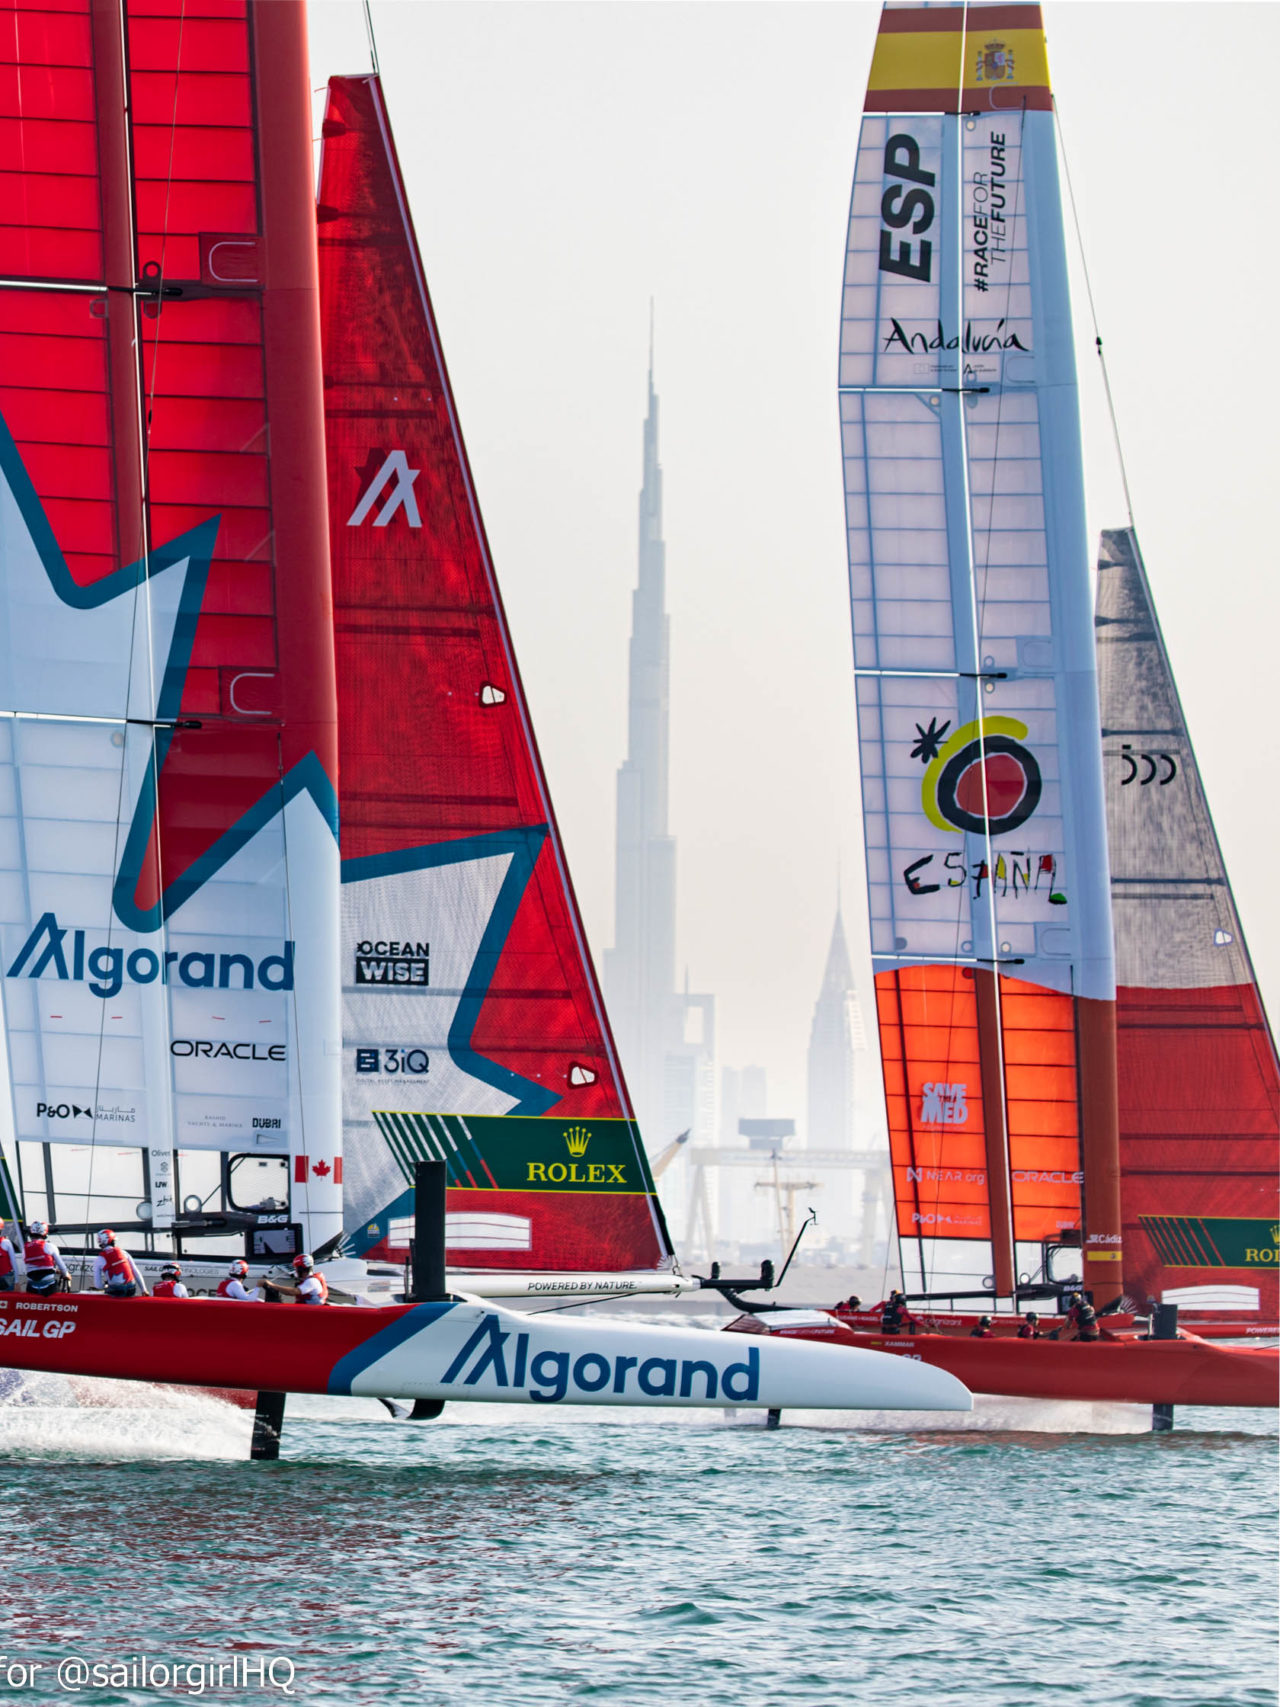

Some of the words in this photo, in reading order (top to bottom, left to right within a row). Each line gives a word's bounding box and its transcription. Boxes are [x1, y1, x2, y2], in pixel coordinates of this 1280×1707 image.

[878, 133, 936, 283] ESP
[990, 131, 1006, 264] THEFUTURE
[973, 171, 989, 293] #RACEFOR
[6, 912, 296, 998] Algorand
[357, 941, 429, 957] OCEAN
[360, 961, 425, 982] WISE
[170, 1040, 286, 1061] ORACLE
[384, 1048, 429, 1073] 3iQ
[36, 1102, 70, 1119] P&O
[96, 1113, 135, 1122] MARINAS
[920, 1102, 968, 1124] MED
[526, 1163, 627, 1184] ROLEX
[1011, 1170, 1084, 1184] ORACLE
[257, 1215, 288, 1223] B&G
[527, 1282, 578, 1291] POWERED
[579, 1281, 593, 1290] BY
[16, 1302, 78, 1313] ROBERTSON
[441, 1314, 759, 1401] Algorand
